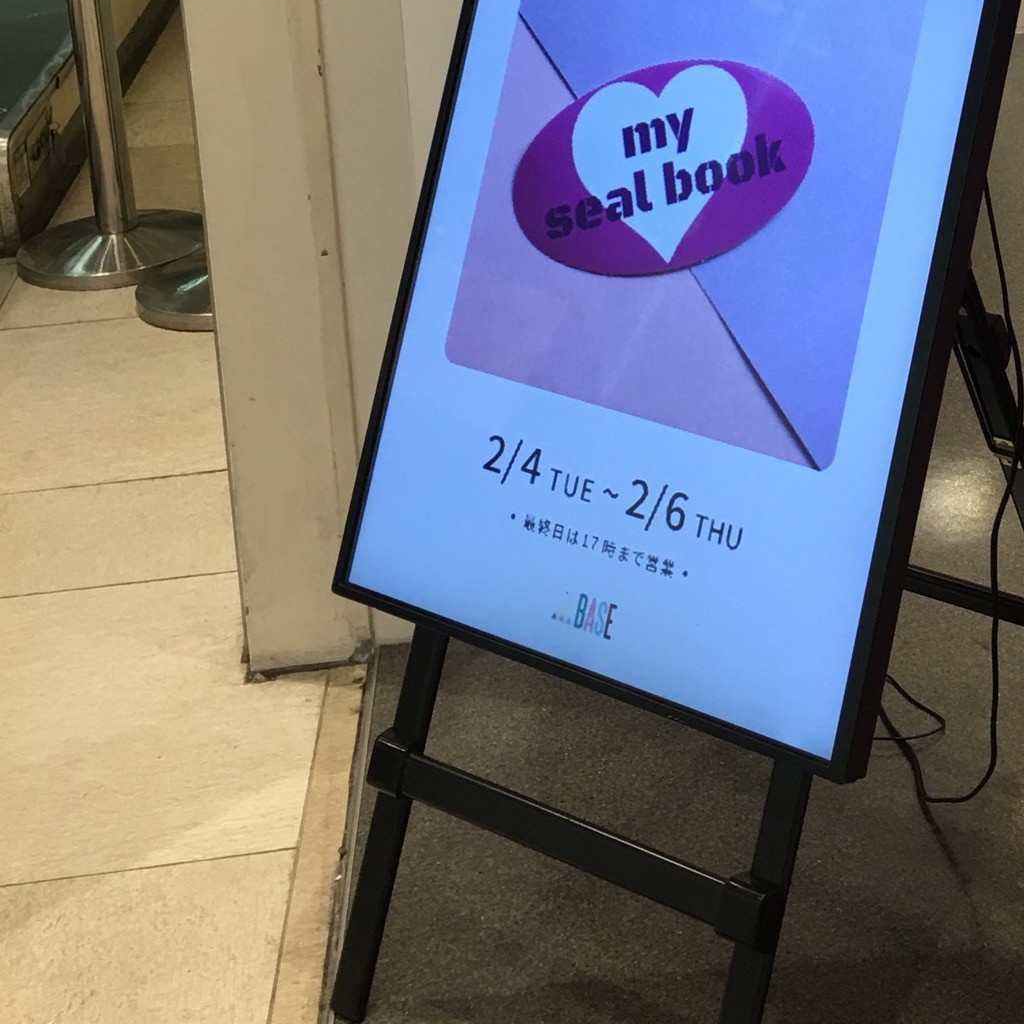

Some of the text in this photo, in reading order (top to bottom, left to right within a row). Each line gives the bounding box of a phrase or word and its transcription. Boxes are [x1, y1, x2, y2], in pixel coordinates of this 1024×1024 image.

[621, 107, 694, 159] my
[544, 132, 787, 240] seal book
[482, 434, 542, 485] 2/4
[550, 467, 595, 503] TUE
[625, 478, 689, 532] 2/6
[696, 513, 743, 551] THU
[573, 592, 618, 641] BASE
